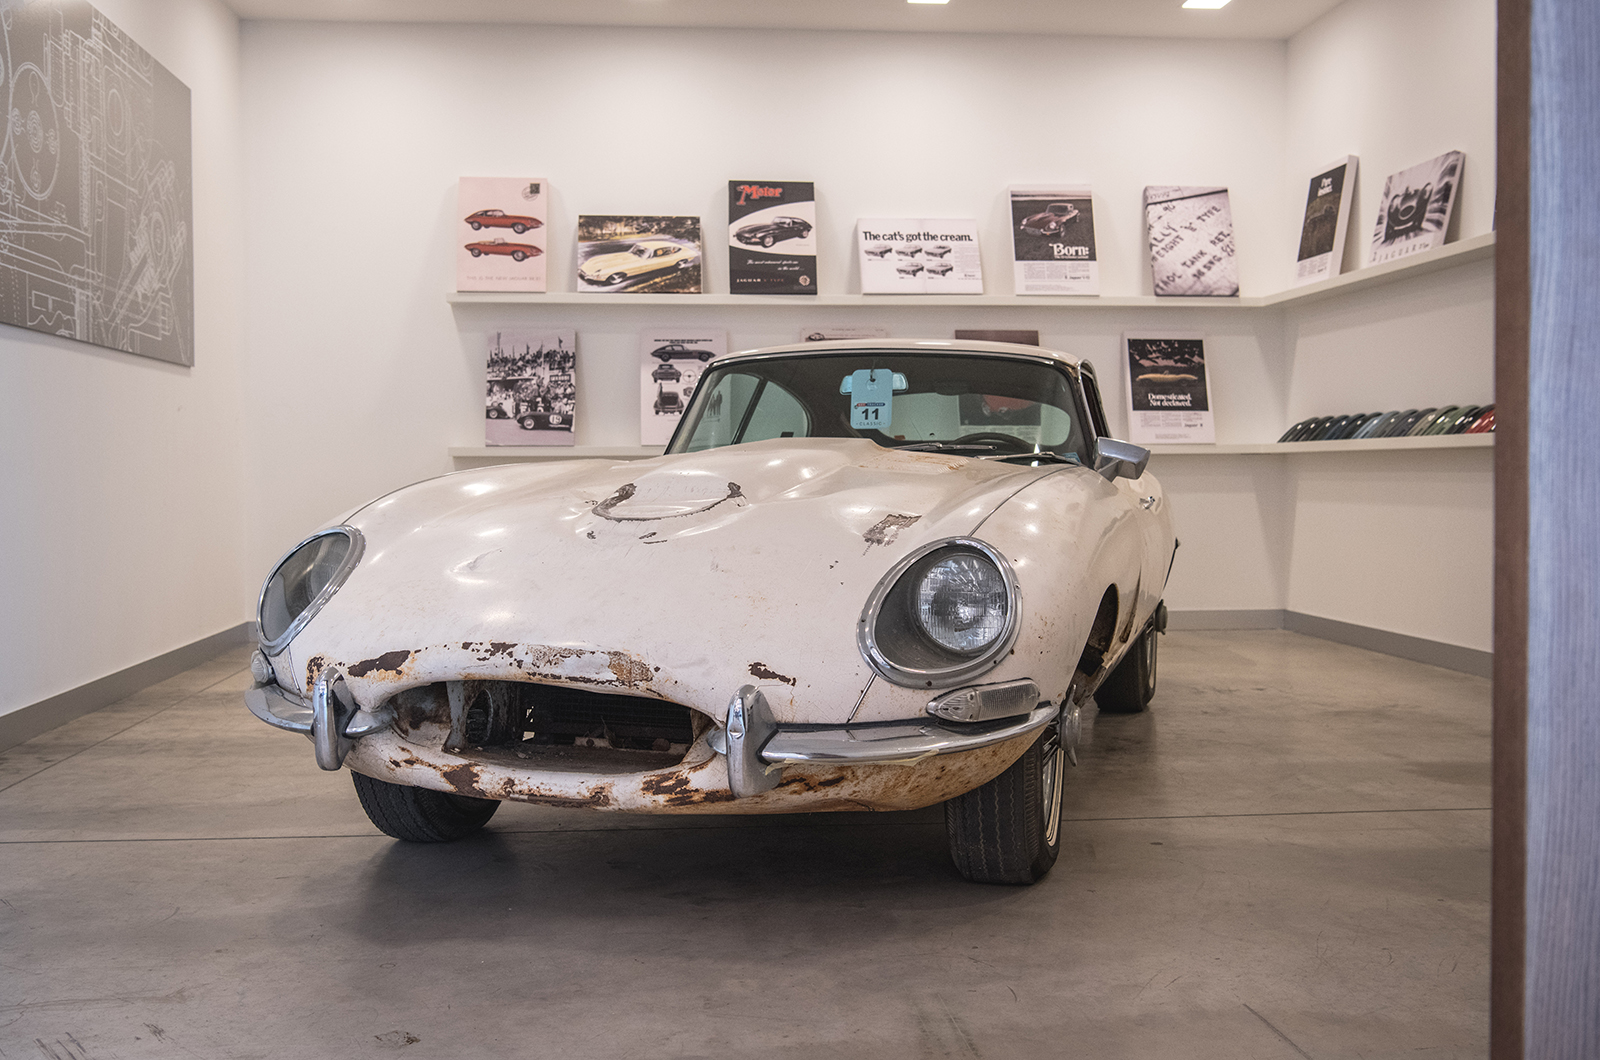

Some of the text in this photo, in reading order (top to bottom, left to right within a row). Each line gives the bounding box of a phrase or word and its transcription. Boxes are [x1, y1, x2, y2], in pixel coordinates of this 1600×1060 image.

[736, 185, 783, 206] Motor
[862, 231, 973, 243] The cat's got the cream.
[1048, 243, 1089, 256] Born:
[861, 408, 879, 420] 11
